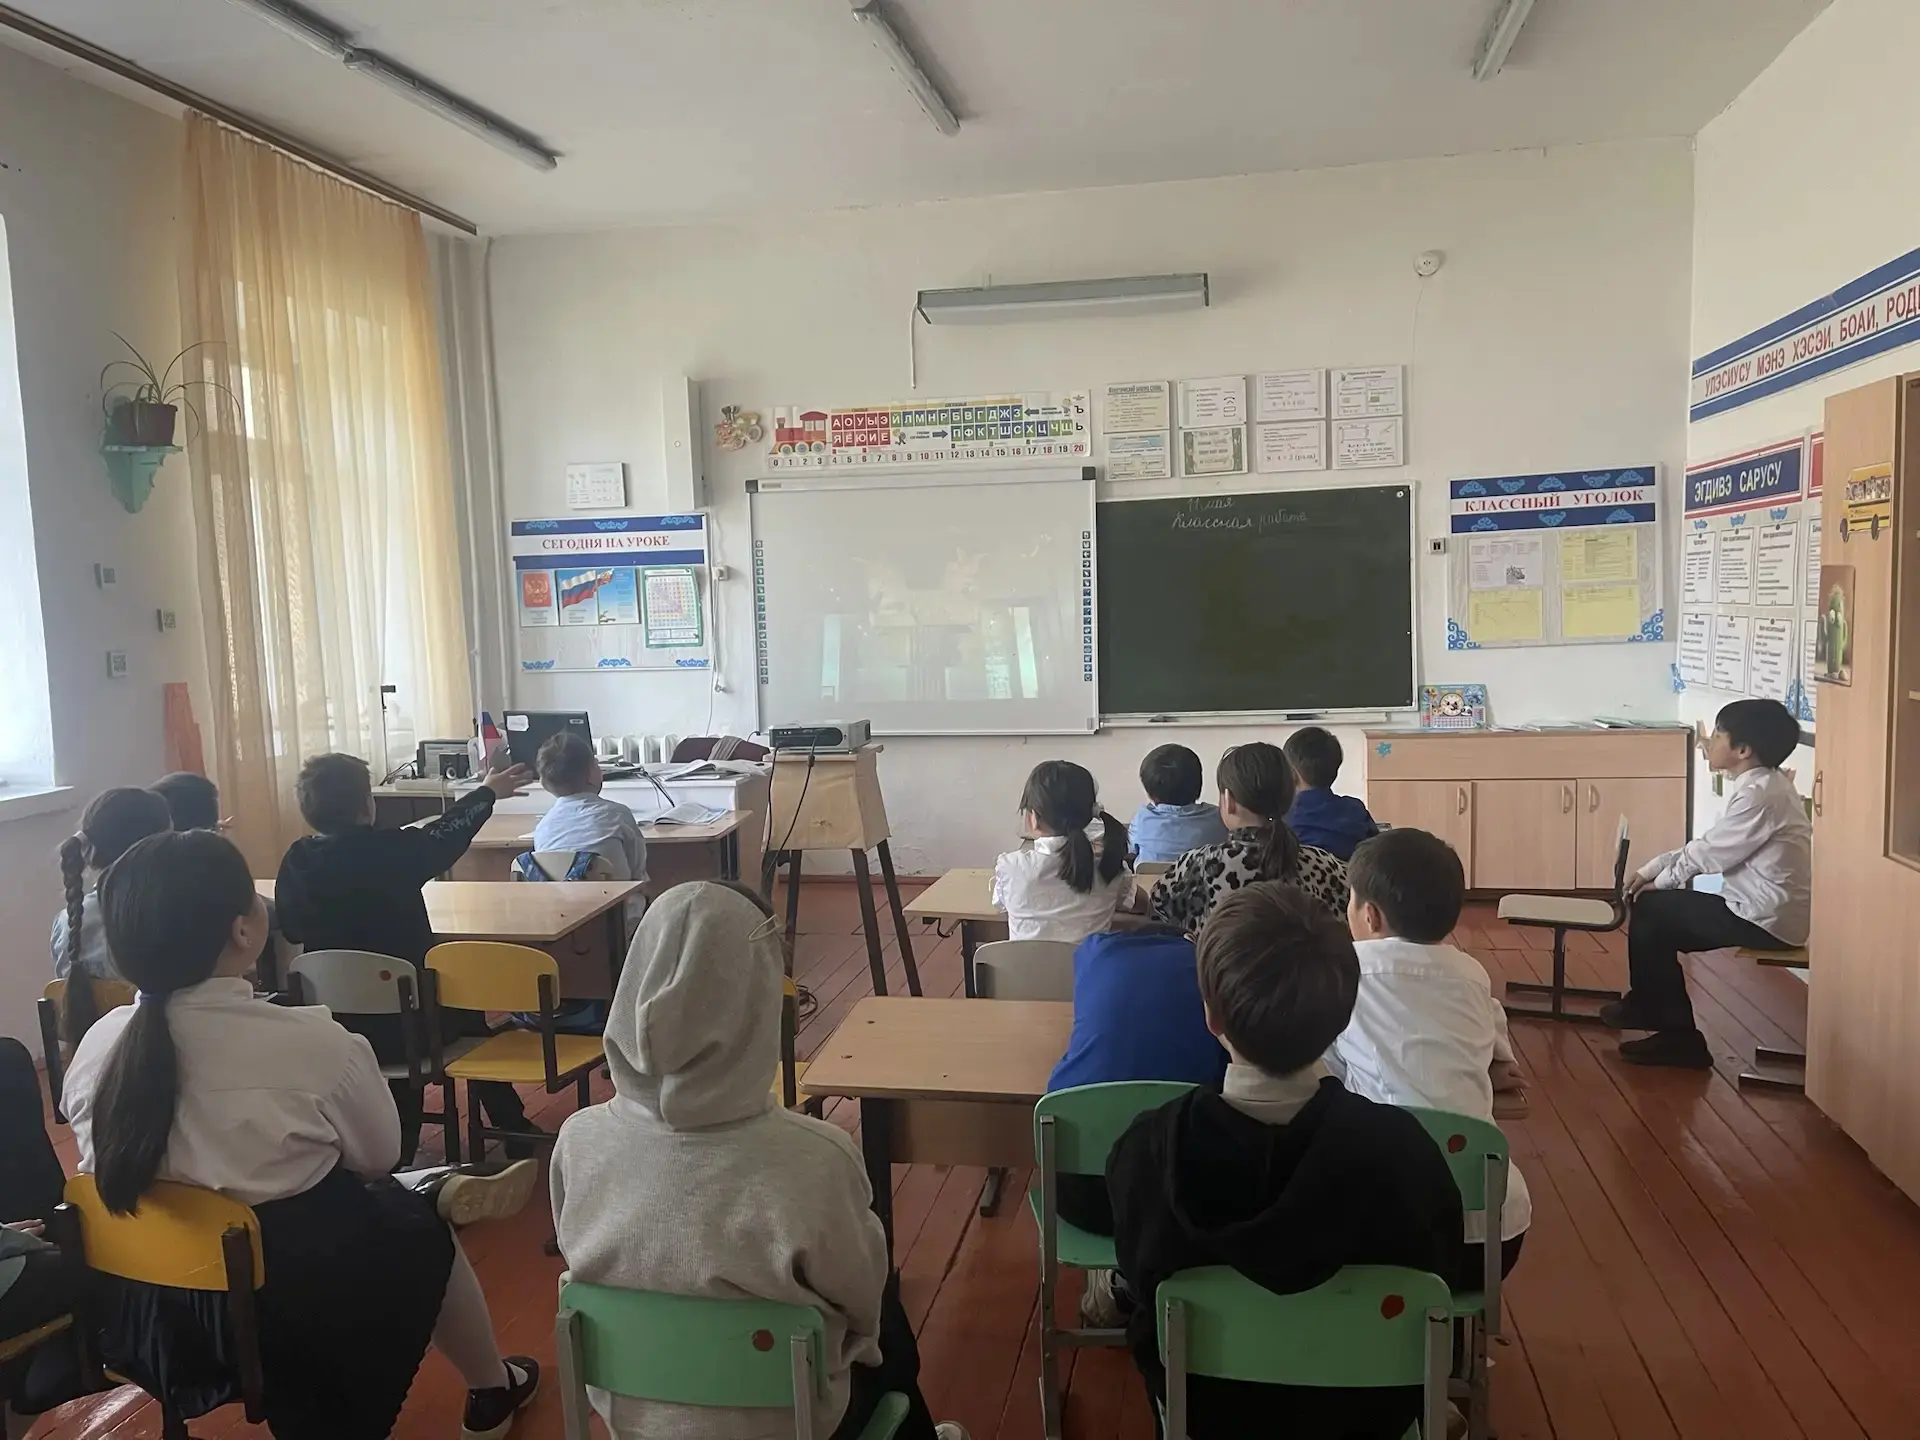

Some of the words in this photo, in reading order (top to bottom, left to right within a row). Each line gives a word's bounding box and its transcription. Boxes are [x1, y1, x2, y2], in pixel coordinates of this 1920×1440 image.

[1705, 361, 1751, 398] УЛЭСИУСУ
[1757, 348, 1785, 377] МЭНЭ
[1792, 325, 1834, 362] ХЭСЭИ,
[1839, 305, 1879, 342] БОАИ,
[950, 451, 960, 459] 12
[966, 450, 975, 458] 13
[1012, 448, 1021, 456] 16
[1027, 447, 1037, 455] 17
[1043, 446, 1052, 454] 18
[1058, 445, 1068, 453] 19
[1074, 444, 1084, 452] 20
[1694, 475, 1732, 503] ЭГДИВЭ
[1739, 460, 1782, 493] САРУСУ
[1464, 493, 1560, 512] КЛАССНЫЙ
[1573, 489, 1644, 505] УГОЛОК
[1172, 510, 1252, 529] Классная
[542, 536, 602, 550] СЕГОДНЯ
[606, 536, 623, 548] НА
[626, 535, 670, 547] УРОКЕ
